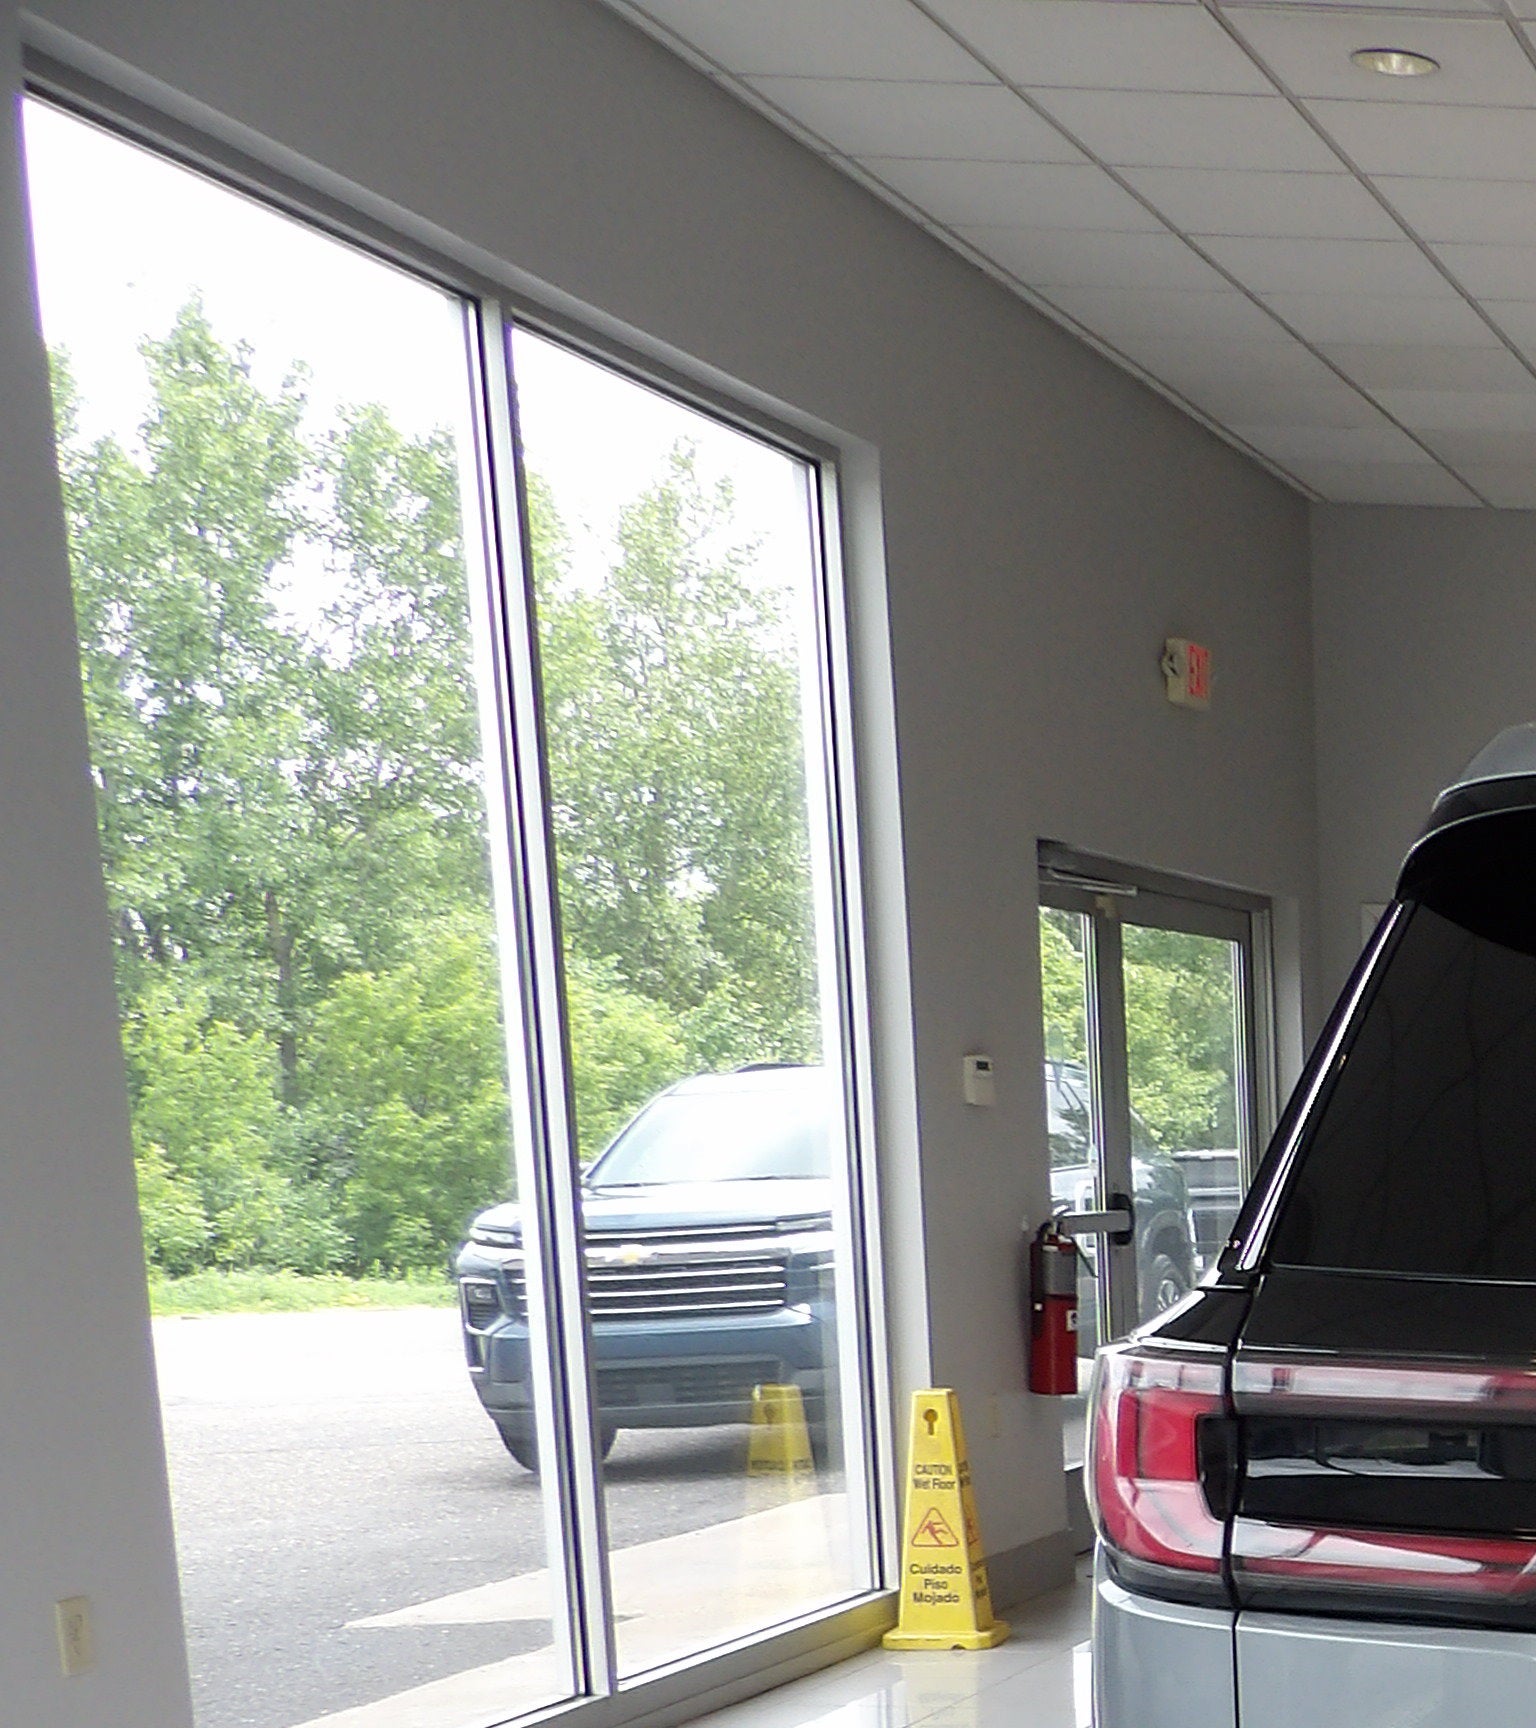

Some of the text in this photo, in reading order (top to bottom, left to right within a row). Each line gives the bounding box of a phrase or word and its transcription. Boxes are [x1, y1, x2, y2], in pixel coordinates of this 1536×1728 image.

[914, 1464, 953, 1475] CAUTION
[909, 1563, 963, 1575] Cuidado
[924, 1578, 948, 1590] Piso
[912, 1592, 960, 1605] Mojado
